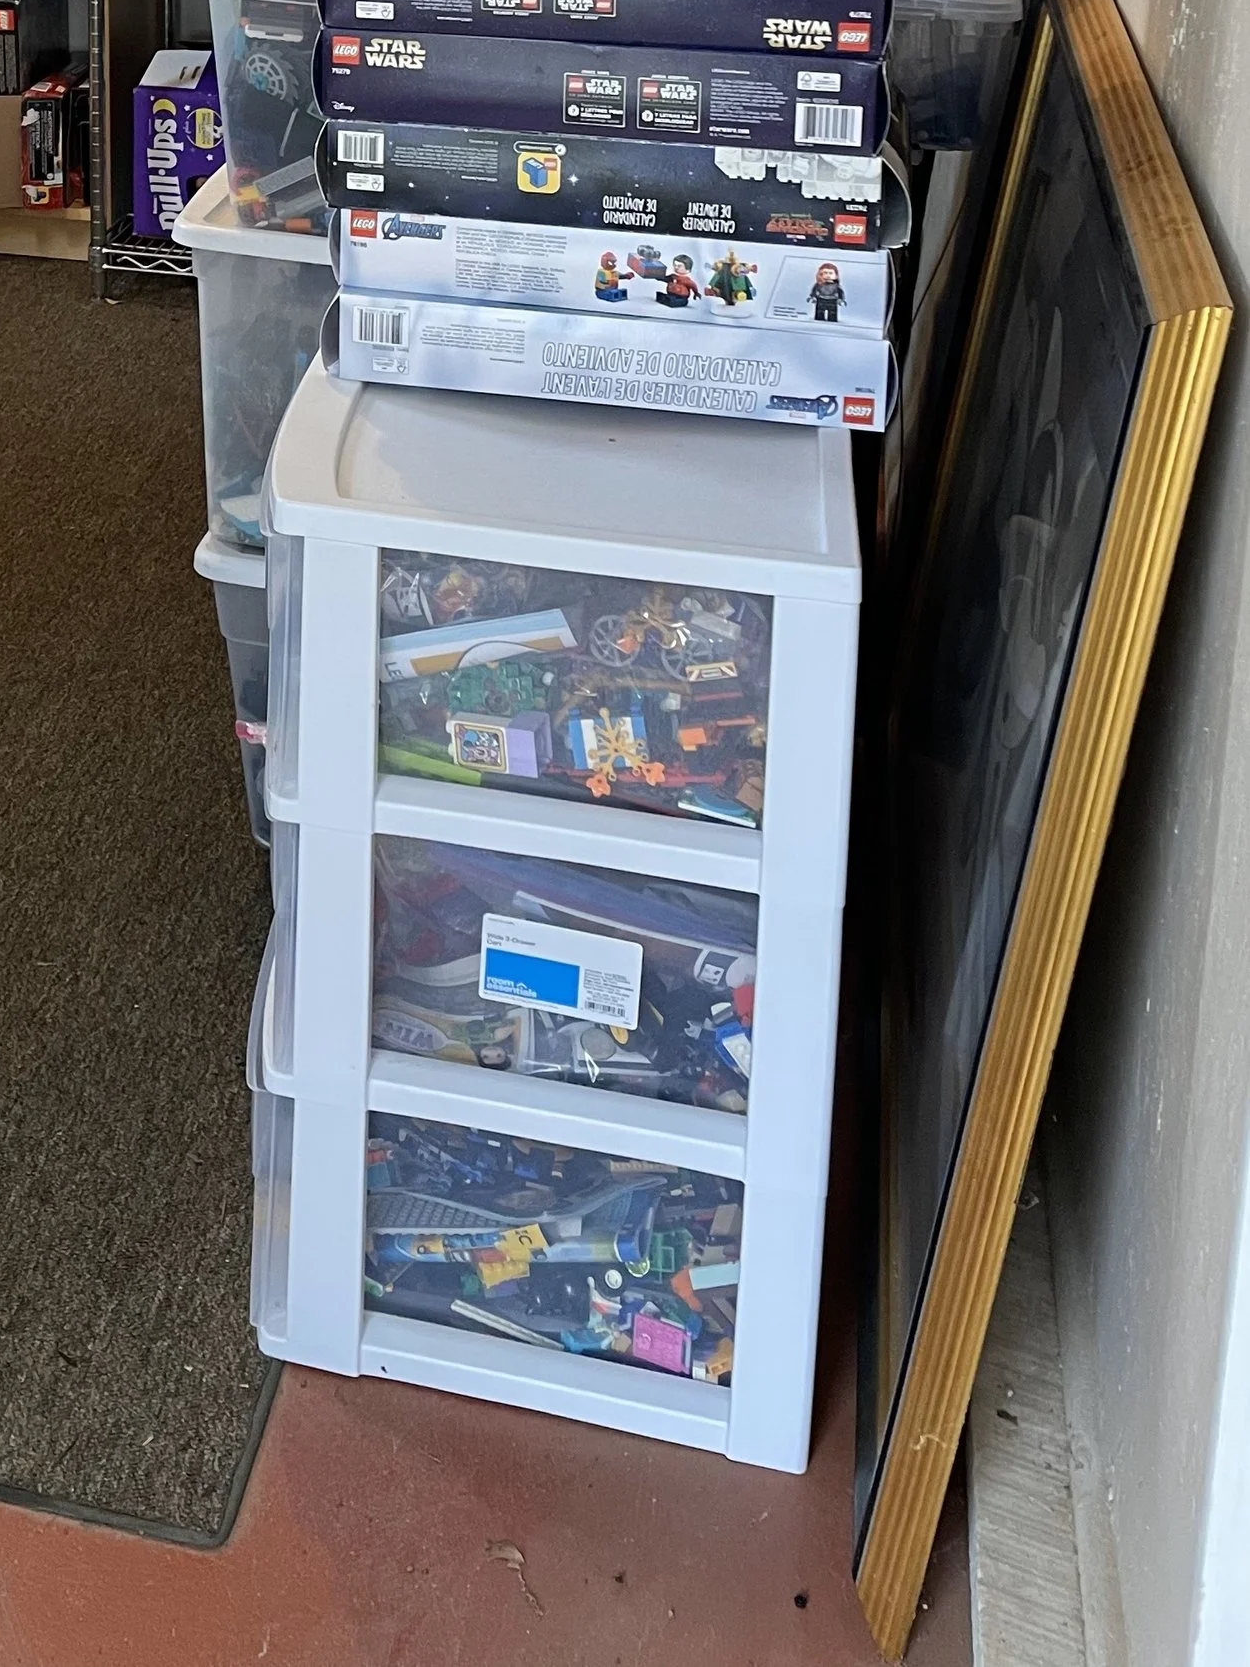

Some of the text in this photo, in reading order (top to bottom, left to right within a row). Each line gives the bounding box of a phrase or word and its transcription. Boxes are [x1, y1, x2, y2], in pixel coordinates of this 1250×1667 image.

[485, 0, 519, 9] STAR
[557, 2, 593, 12] STAR
[0, 11, 8, 30] LEGO
[763, 19, 832, 35] WARS
[334, 38, 425, 56] LEGO STAR
[763, 31, 868, 50] LEGO STAR
[365, 52, 425, 69] WARS
[587, 79, 621, 88] STAR
[662, 84, 697, 93] STAR
[586, 86, 621, 96] WARS
[660, 90, 697, 100] WARS
[331, 101, 355, 113] Disney
[602, 195, 658, 212] DE ADVIENTO
[720, 205, 732, 218] DE
[352, 218, 376, 230] LEGO
[603, 211, 656, 227] CALENDARIO
[682, 216, 736, 233] CALENDRIER
[837, 224, 864, 236] LEGO
[543, 342, 782, 387] CALENDARIO DE ADVIENTO
[542, 372, 758, 413] CALENDRIER DE L'AVENT
[846, 405, 872, 417] LEGO
[487, 977, 513, 986] room
[487, 983, 537, 998] essentials
